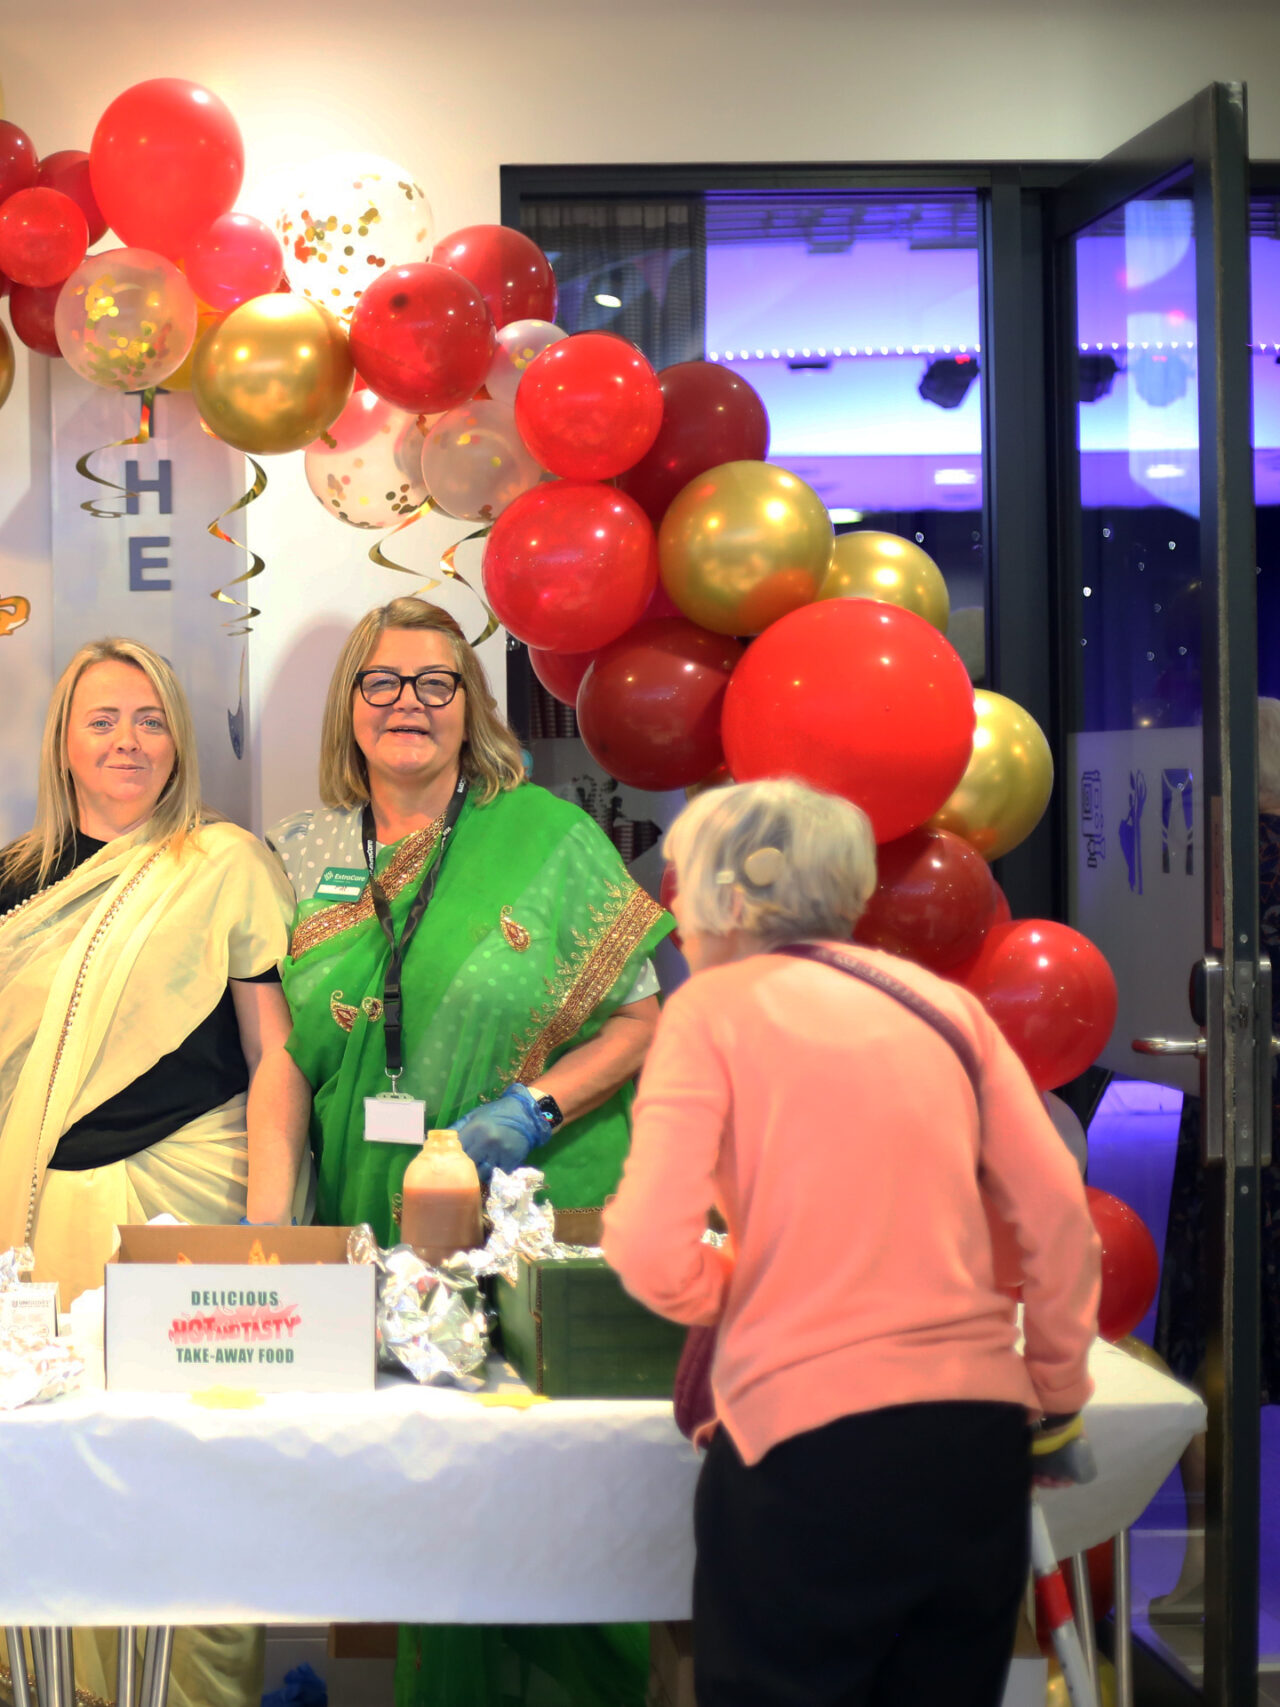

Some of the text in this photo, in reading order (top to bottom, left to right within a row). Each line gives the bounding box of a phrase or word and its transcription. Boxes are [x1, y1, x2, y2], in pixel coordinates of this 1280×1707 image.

[334, 873, 366, 881] ExtraCare
[191, 1291, 280, 1306] DELICIOUS
[170, 1317, 217, 1345] HOT
[240, 1315, 302, 1343] TASTY
[176, 1348, 295, 1363] TAKE-AWAY FOOD
